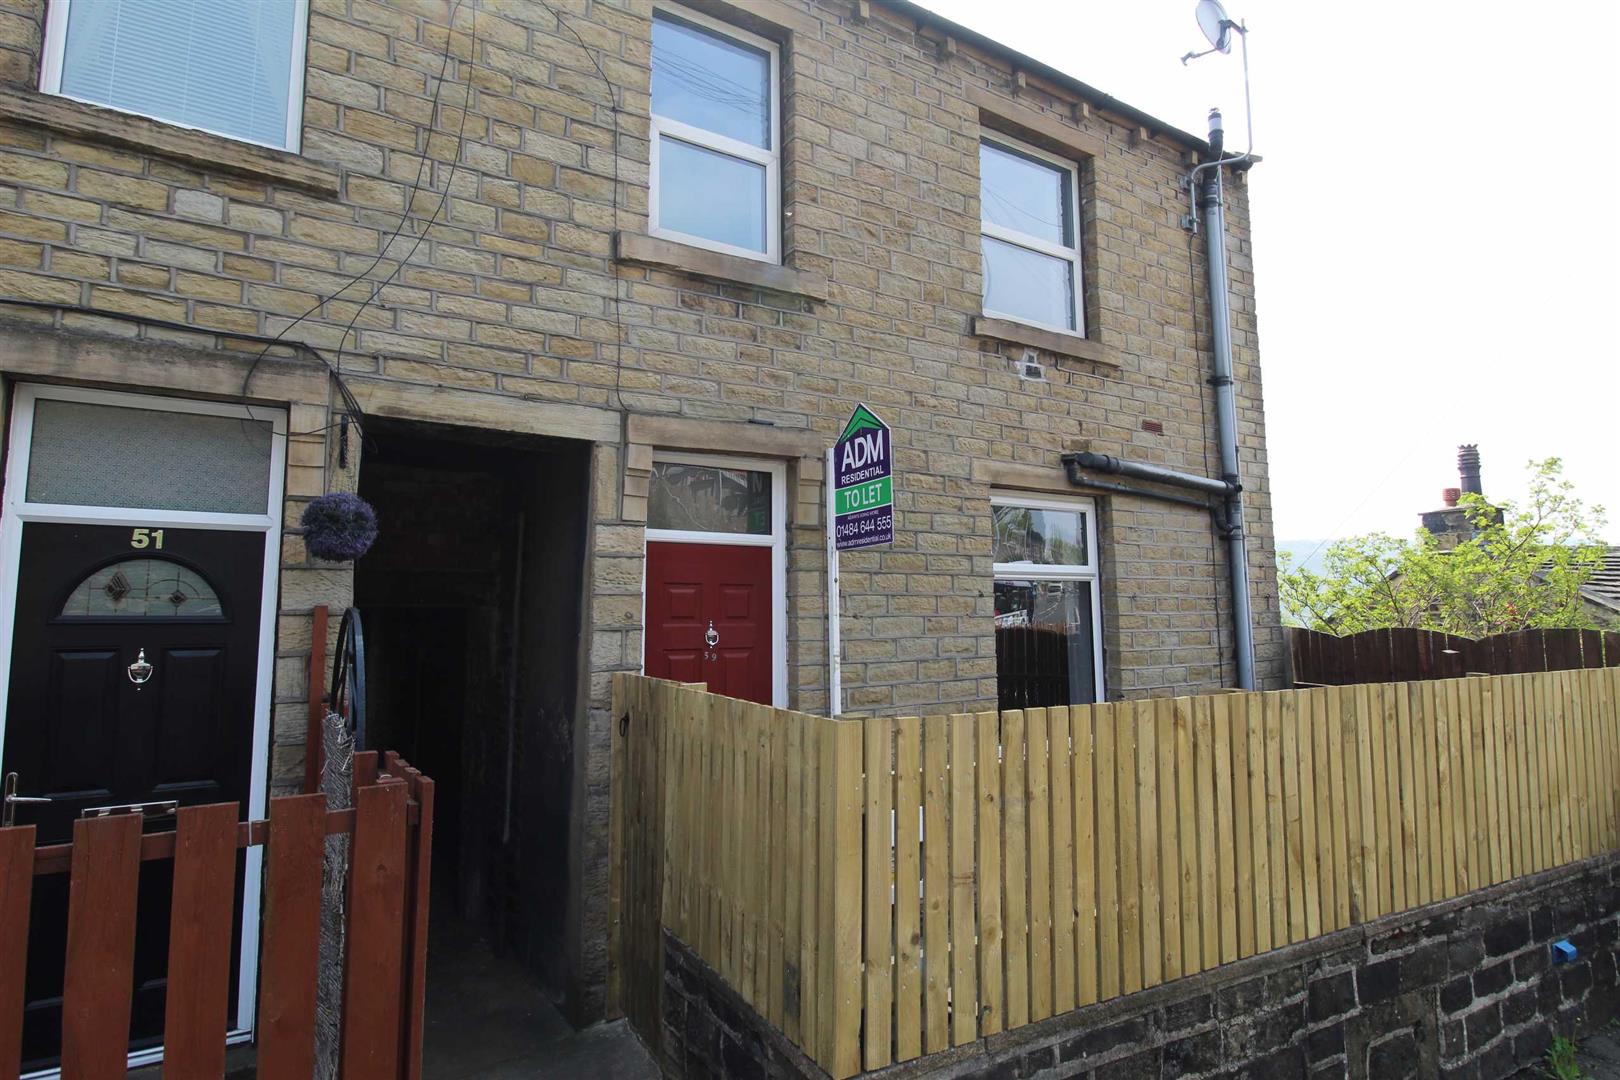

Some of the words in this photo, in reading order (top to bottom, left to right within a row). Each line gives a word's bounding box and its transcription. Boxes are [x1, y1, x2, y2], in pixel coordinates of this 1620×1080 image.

[841, 429, 884, 473] ADM
[841, 465, 884, 485] RESIDENTIAL
[844, 489, 860, 509] TO
[862, 483, 882, 505] LET
[836, 523, 858, 538] 01484
[860, 519, 875, 534] 644
[877, 515, 892, 530] 555
[131, 528, 164, 549] 51
